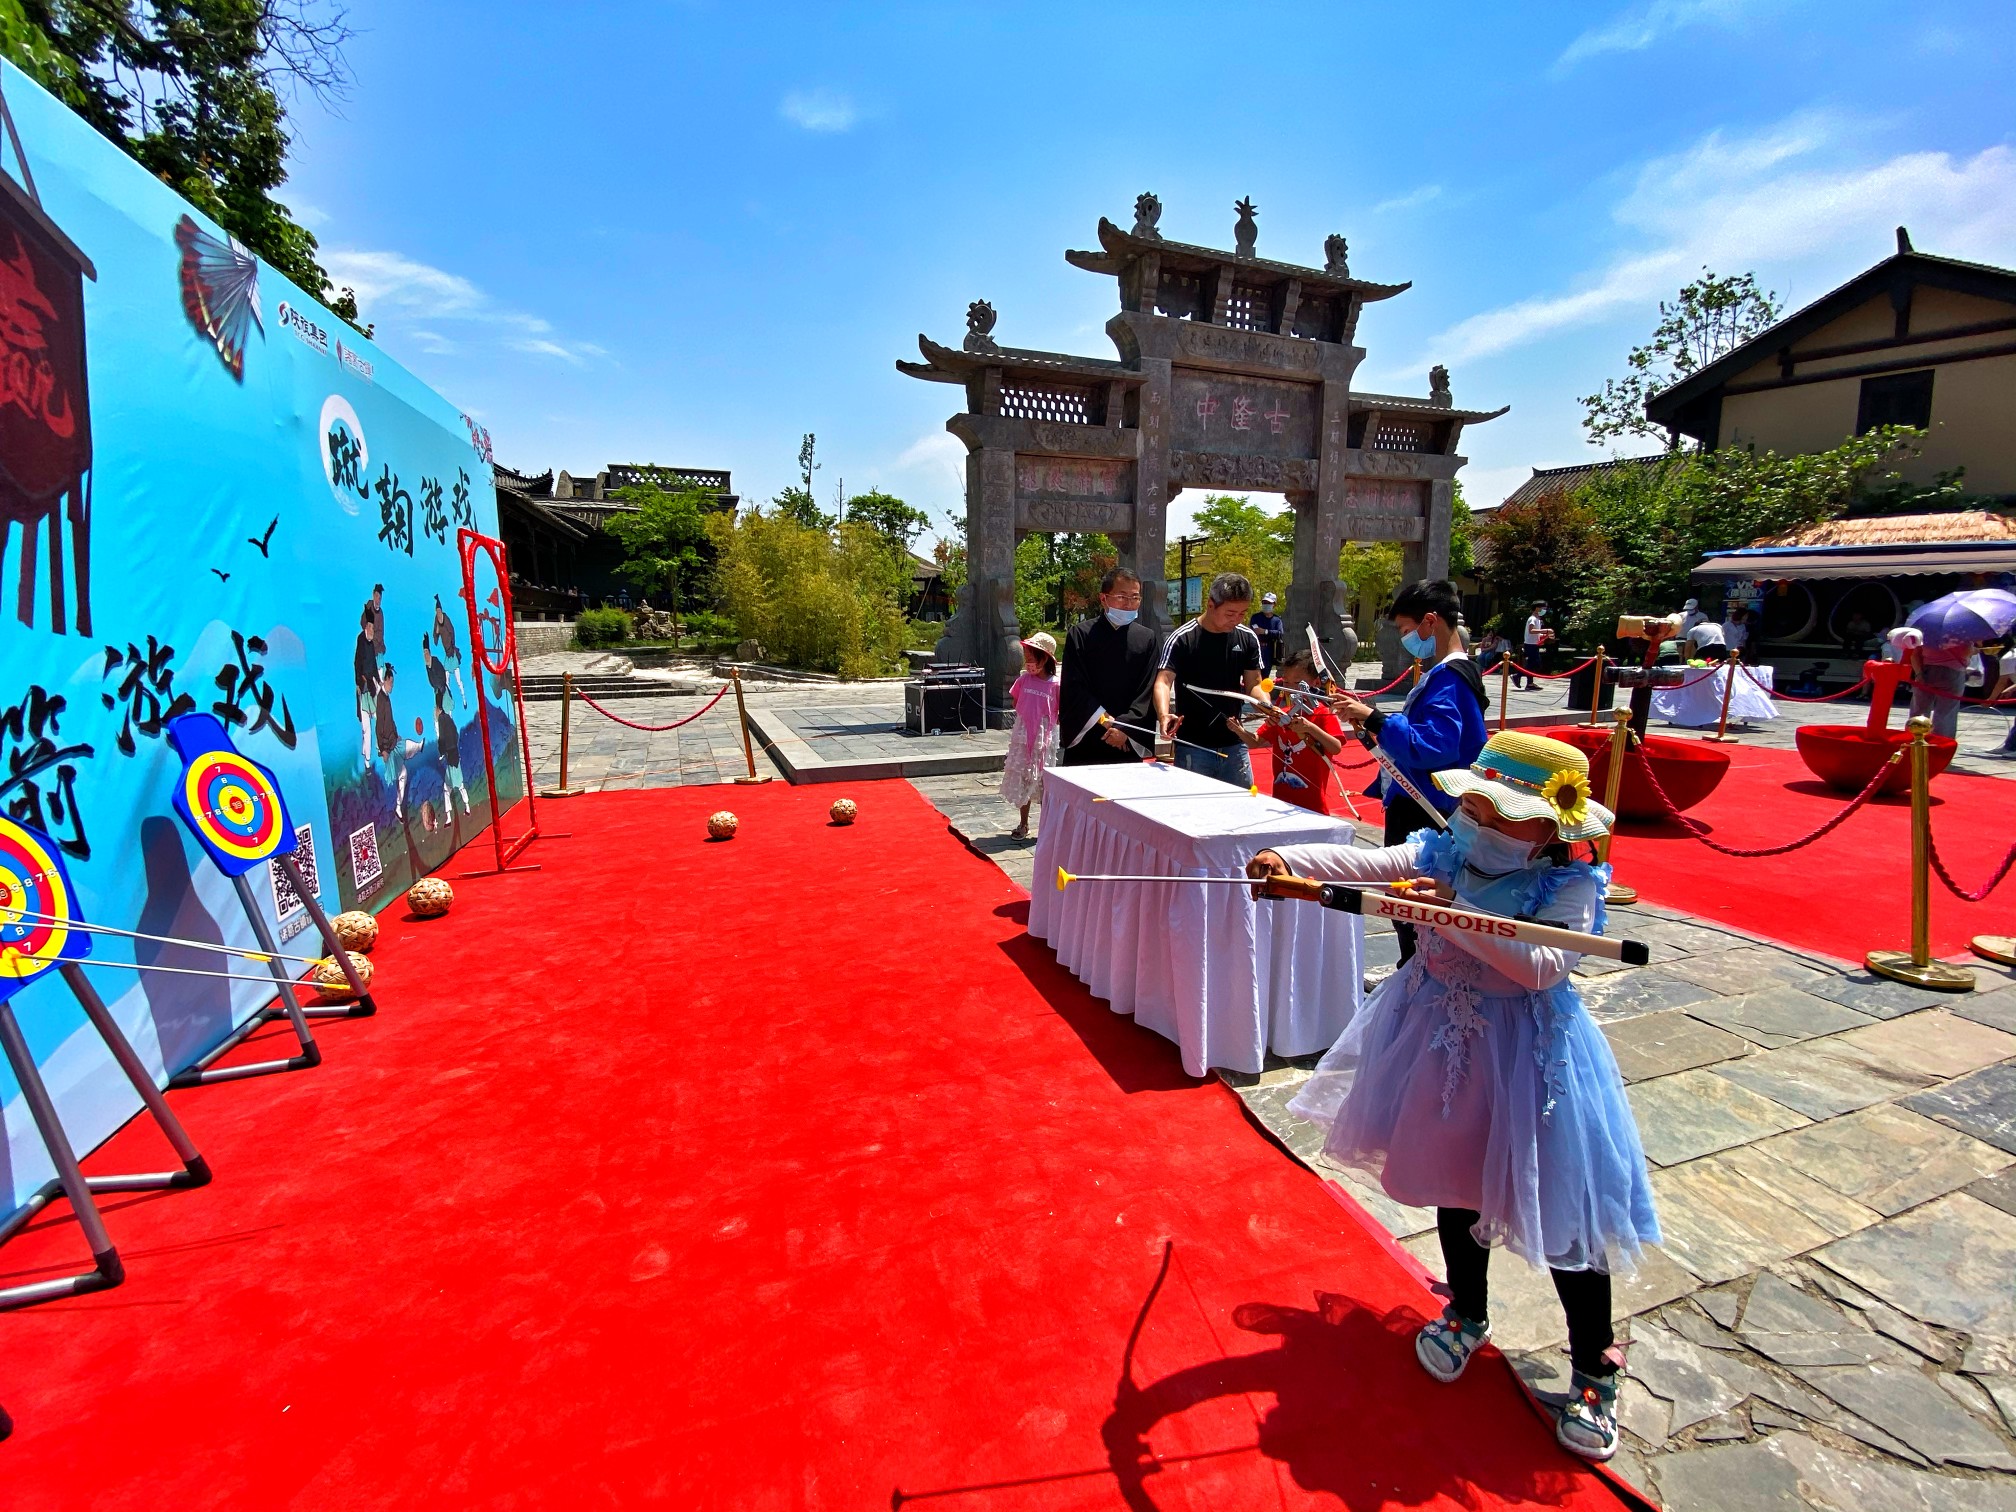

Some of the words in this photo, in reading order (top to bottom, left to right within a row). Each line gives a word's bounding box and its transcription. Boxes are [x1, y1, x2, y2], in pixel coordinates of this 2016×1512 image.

[328, 426, 478, 558] 蹴鞠游戏
[1377, 755, 1422, 801] SHOOTER
[24, 878, 33, 887] 8
[35, 873, 43, 882] 7
[1376, 900, 1517, 938] SHOOTER
[16, 926, 25, 936] 8
[24, 941, 32, 952] 7
